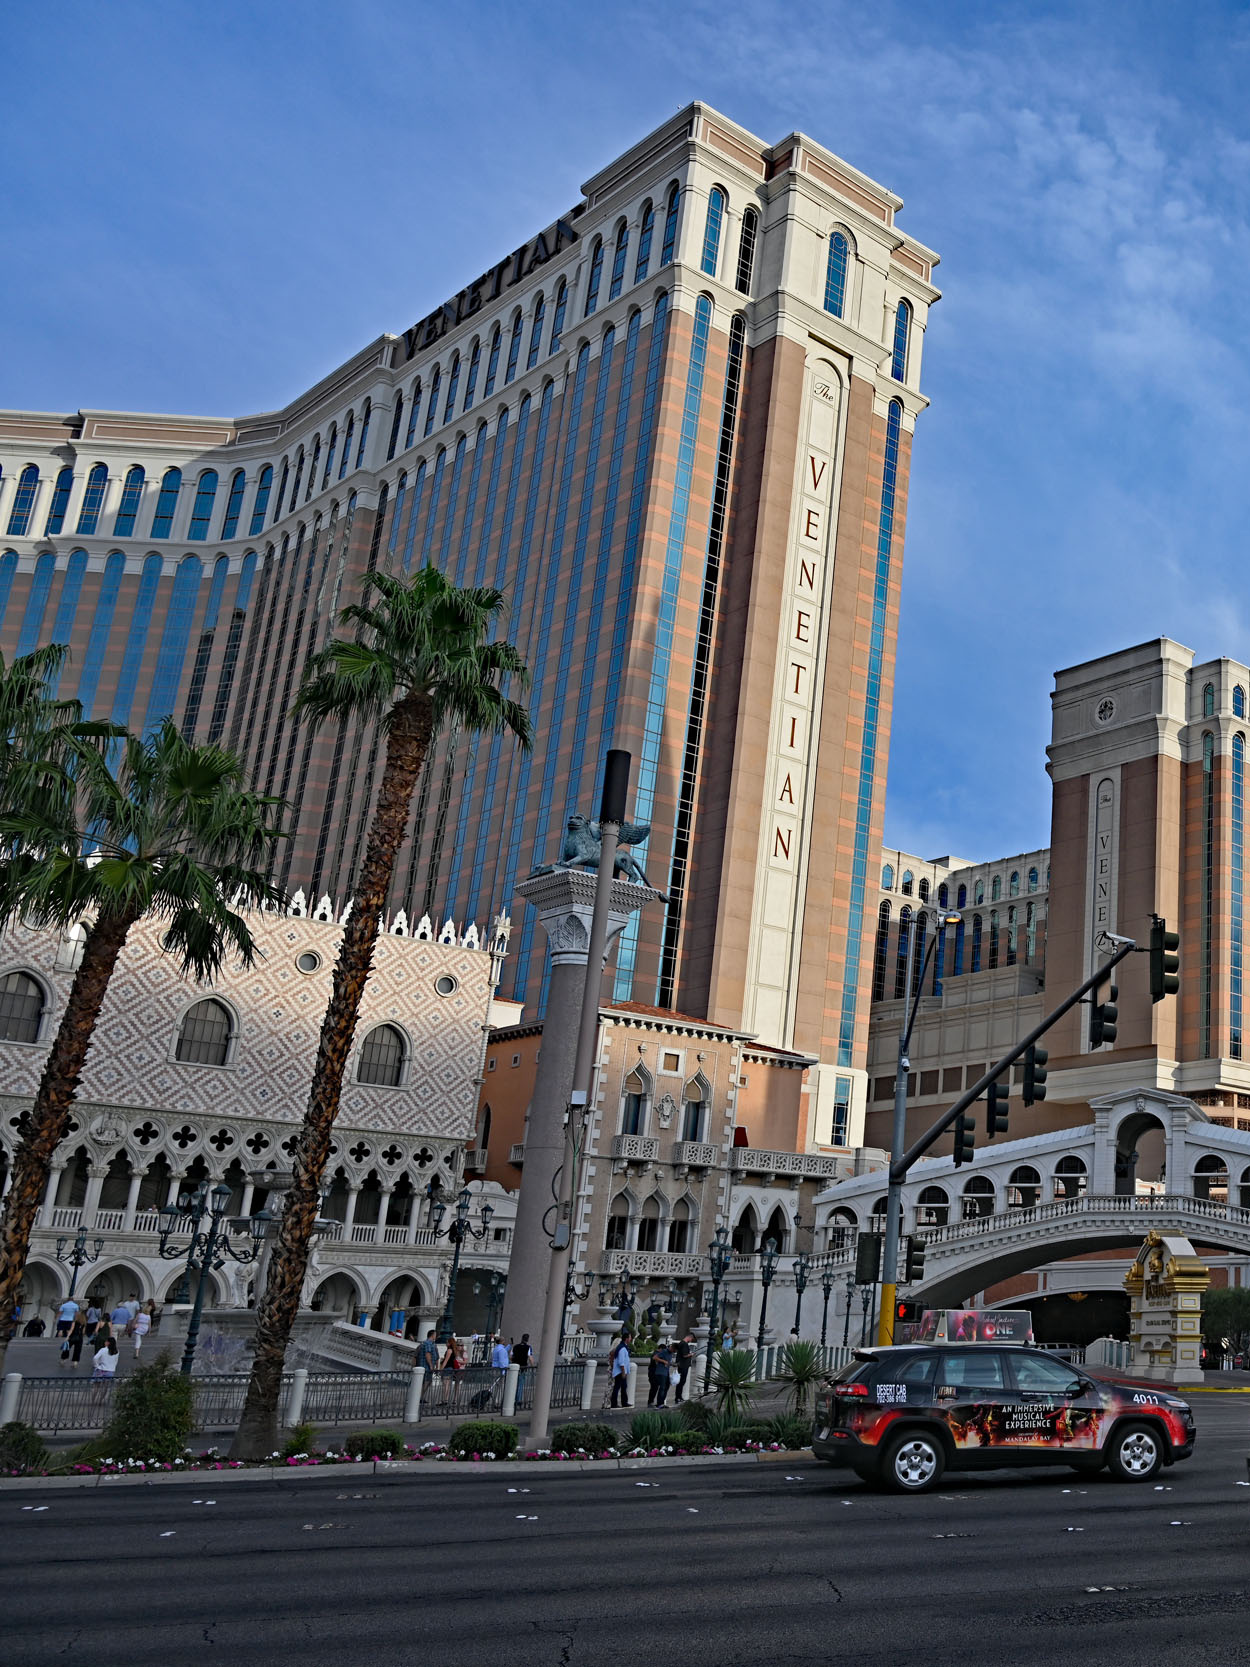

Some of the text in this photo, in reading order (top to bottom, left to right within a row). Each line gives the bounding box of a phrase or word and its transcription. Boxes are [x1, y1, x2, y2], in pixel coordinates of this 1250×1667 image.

[402, 204, 585, 361] VENETIAN
[814, 382, 834, 401] The
[772, 456, 828, 863] VENETIAN
[876, 1384, 907, 1396] DESERT CAB
[1132, 1393, 1159, 1405] 4011
[1002, 1403, 1055, 1413] AN IMMERSIVE
[1012, 1412, 1044, 1421] MUSICAL
[1005, 1419, 1051, 1430] EXPERIENCE
